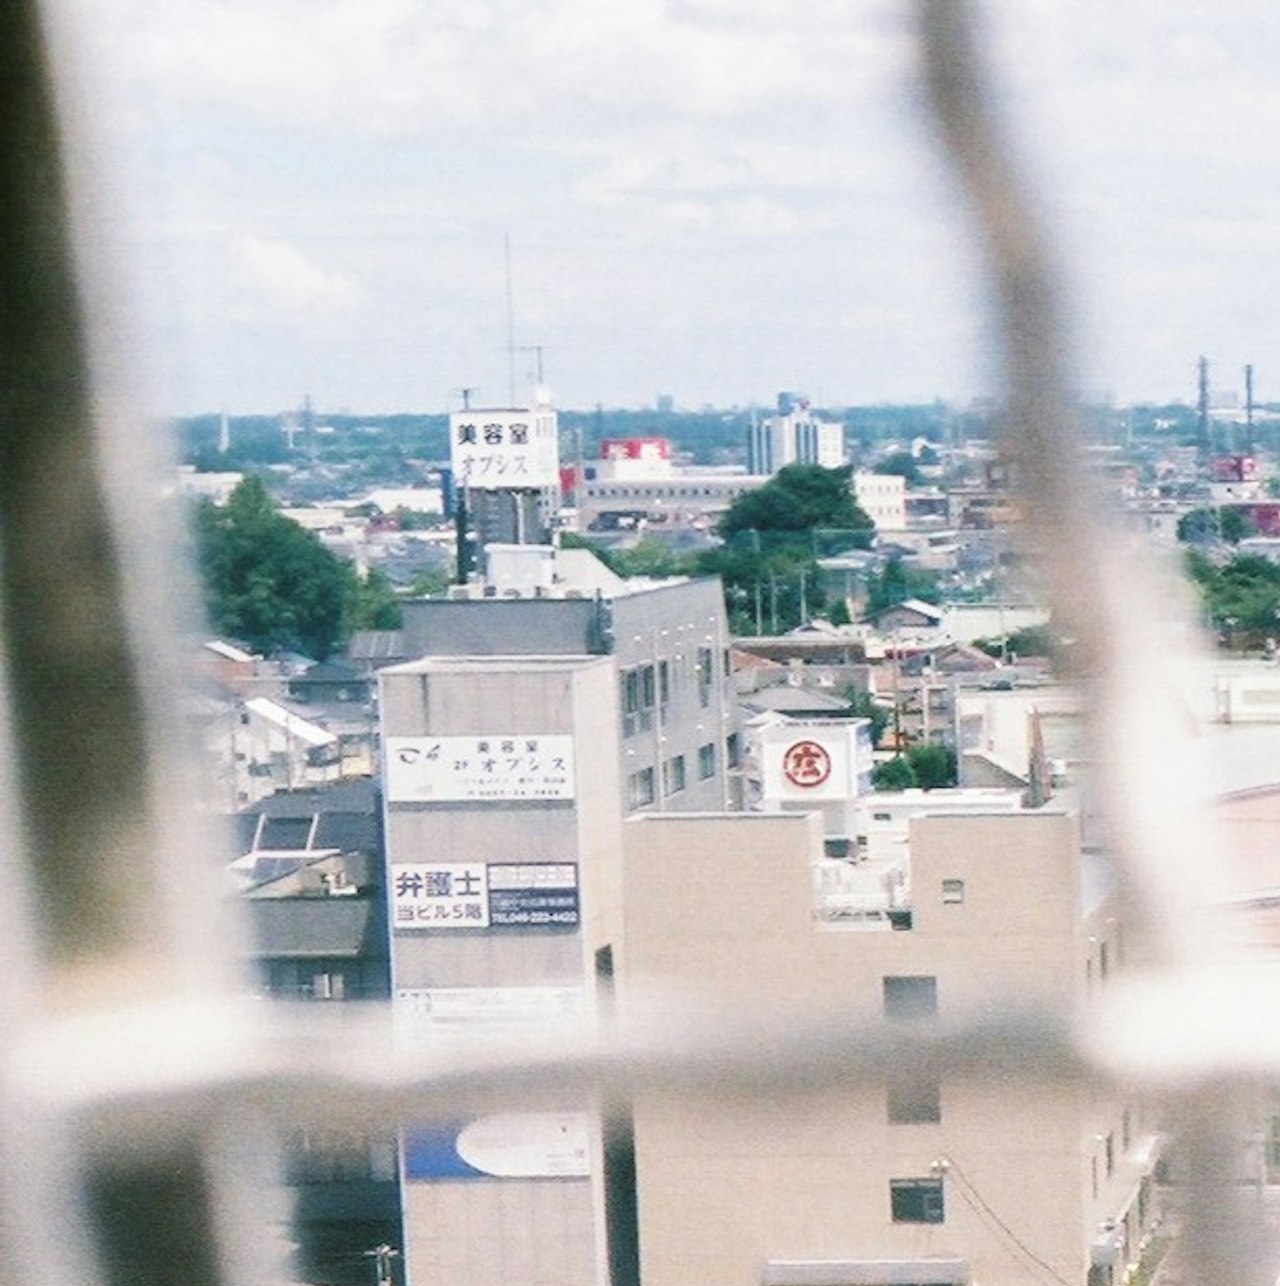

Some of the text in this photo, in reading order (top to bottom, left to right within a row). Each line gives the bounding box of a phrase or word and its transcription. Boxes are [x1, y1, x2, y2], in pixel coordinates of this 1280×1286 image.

[458, 423, 529, 445] 美容室
[396, 870, 481, 898] 弁護士
[397, 903, 482, 921] 当ビル5階
